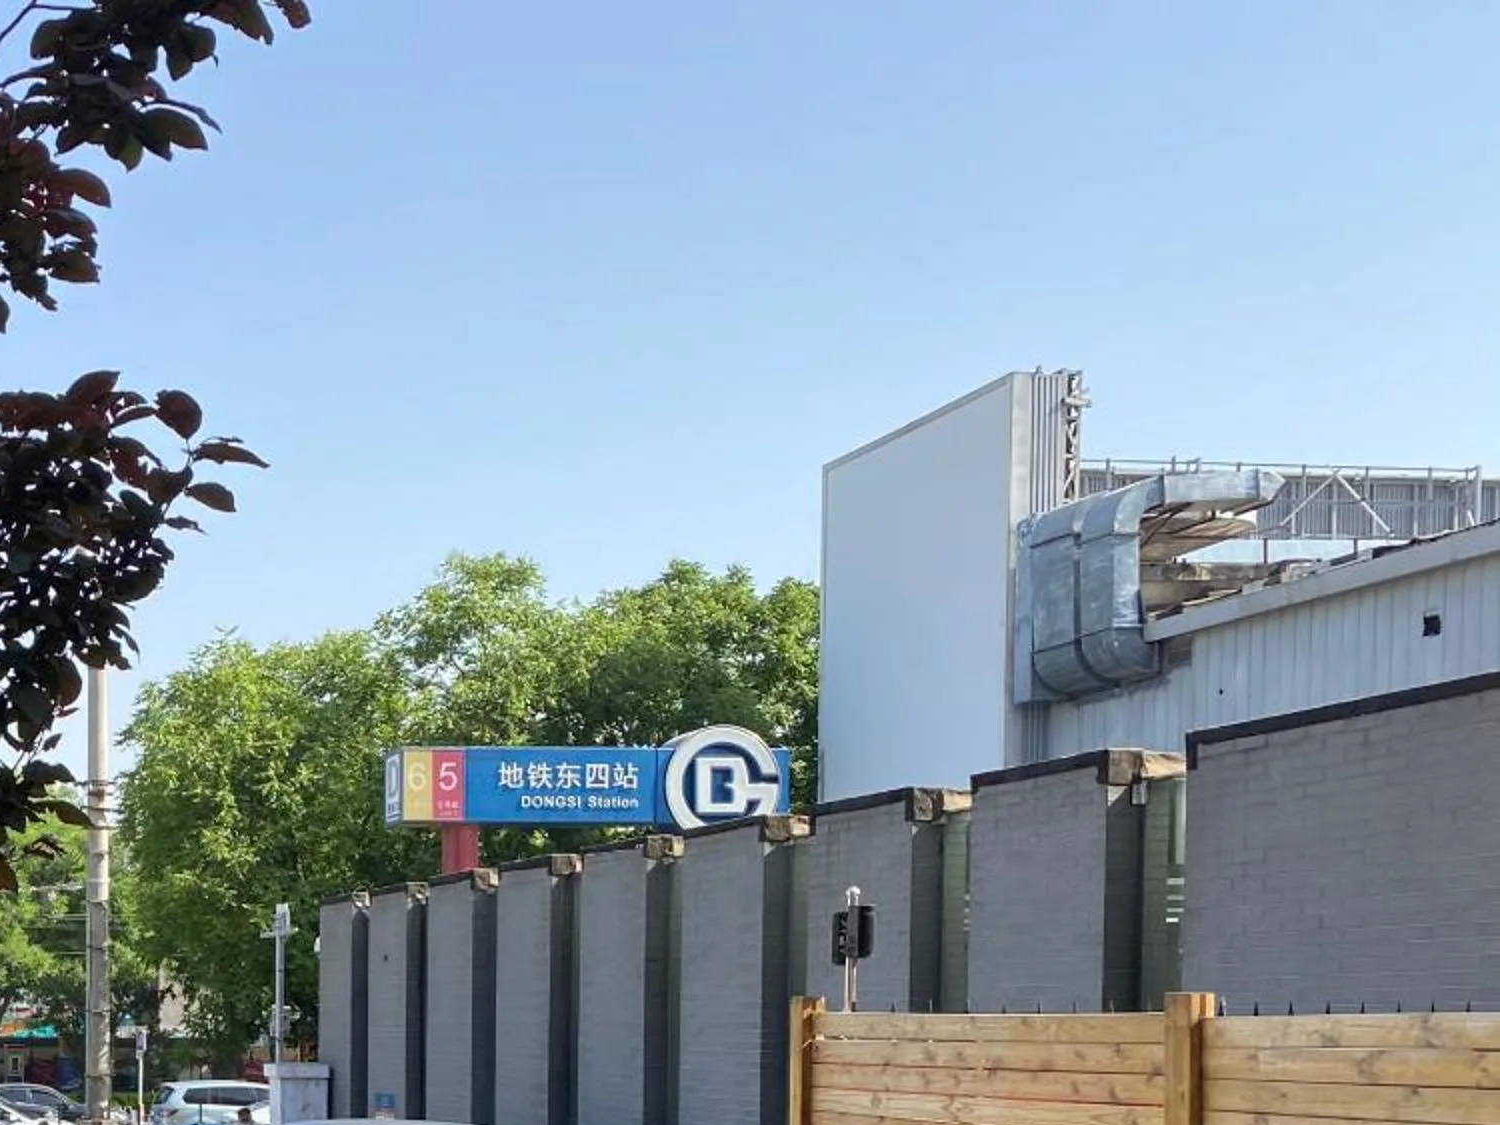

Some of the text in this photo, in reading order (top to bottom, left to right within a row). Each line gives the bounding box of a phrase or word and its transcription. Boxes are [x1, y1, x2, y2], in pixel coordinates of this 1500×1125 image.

[409, 762, 427, 791] 6
[439, 762, 457, 790] 5
[499, 761, 638, 789] 地铁东四站
[521, 795, 639, 808] DONGSI Station
